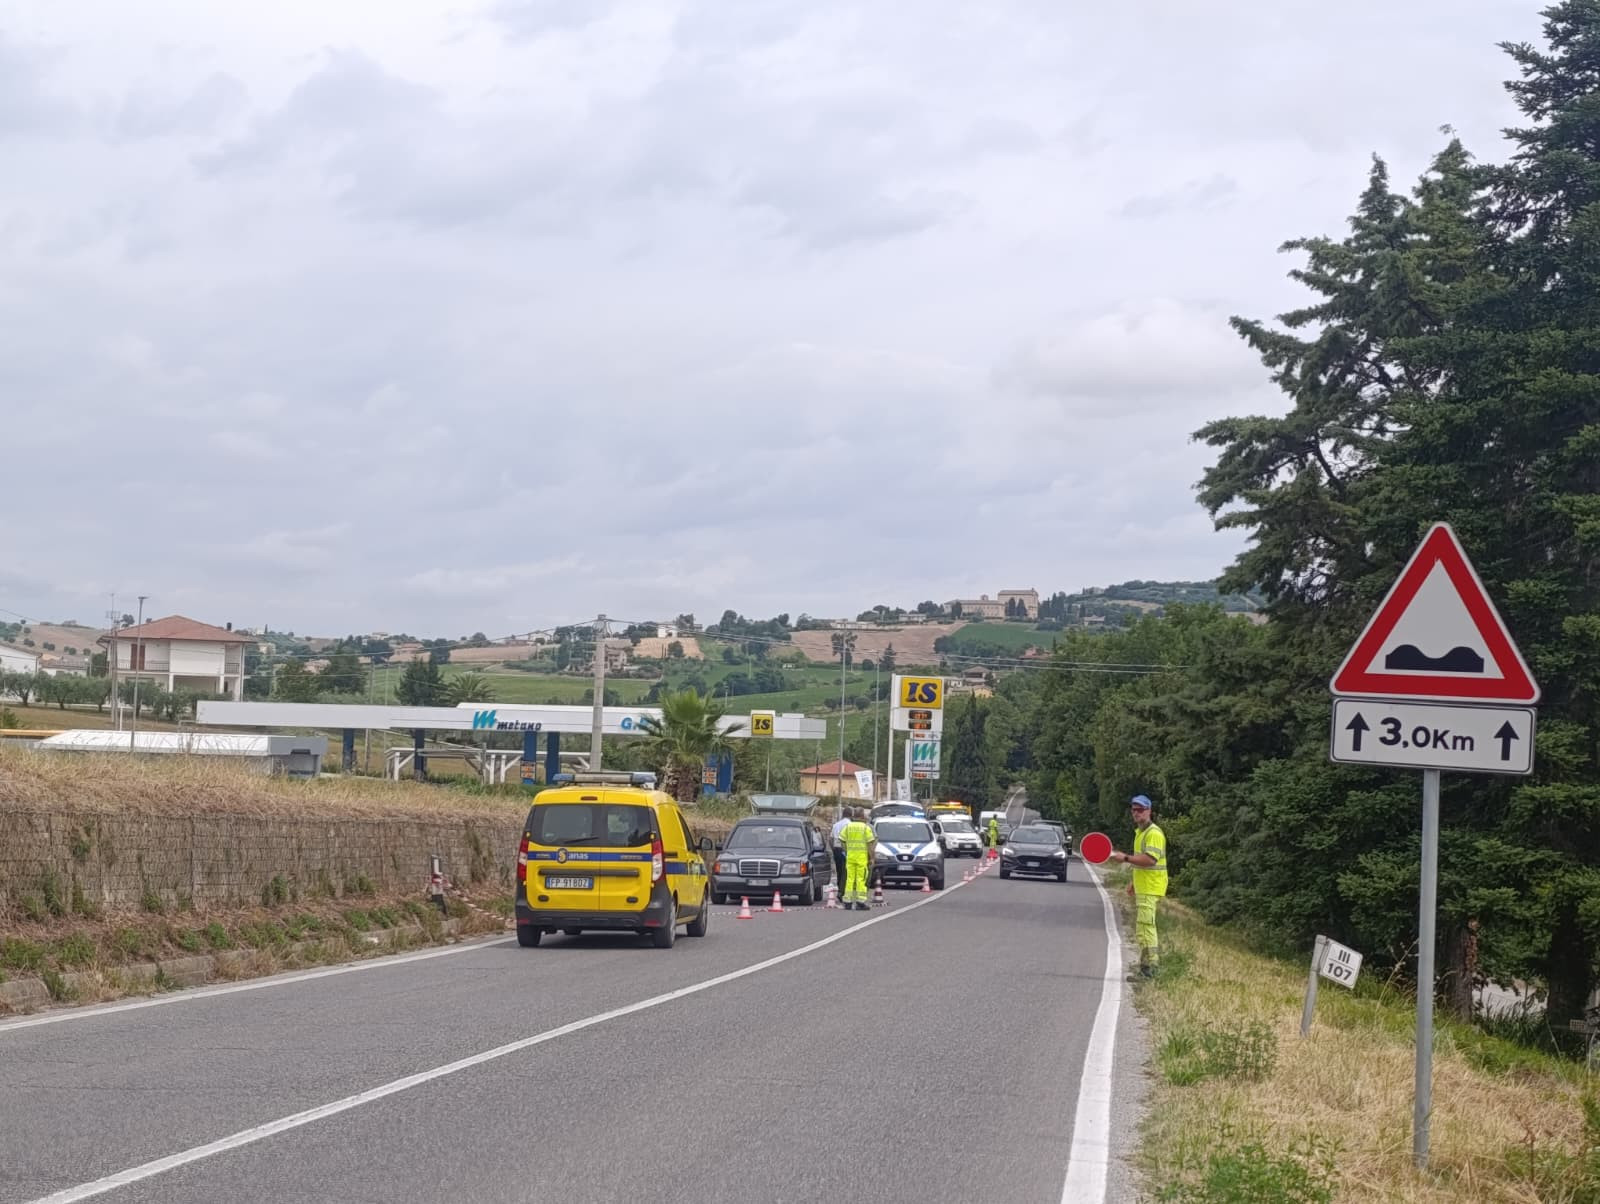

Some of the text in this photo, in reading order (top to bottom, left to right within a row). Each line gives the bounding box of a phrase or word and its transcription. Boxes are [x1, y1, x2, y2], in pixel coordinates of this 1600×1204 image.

[906, 682, 938, 703] IS
[496, 719, 542, 730] metano
[754, 718, 771, 730] IS
[1327, 962, 1352, 981] 107
